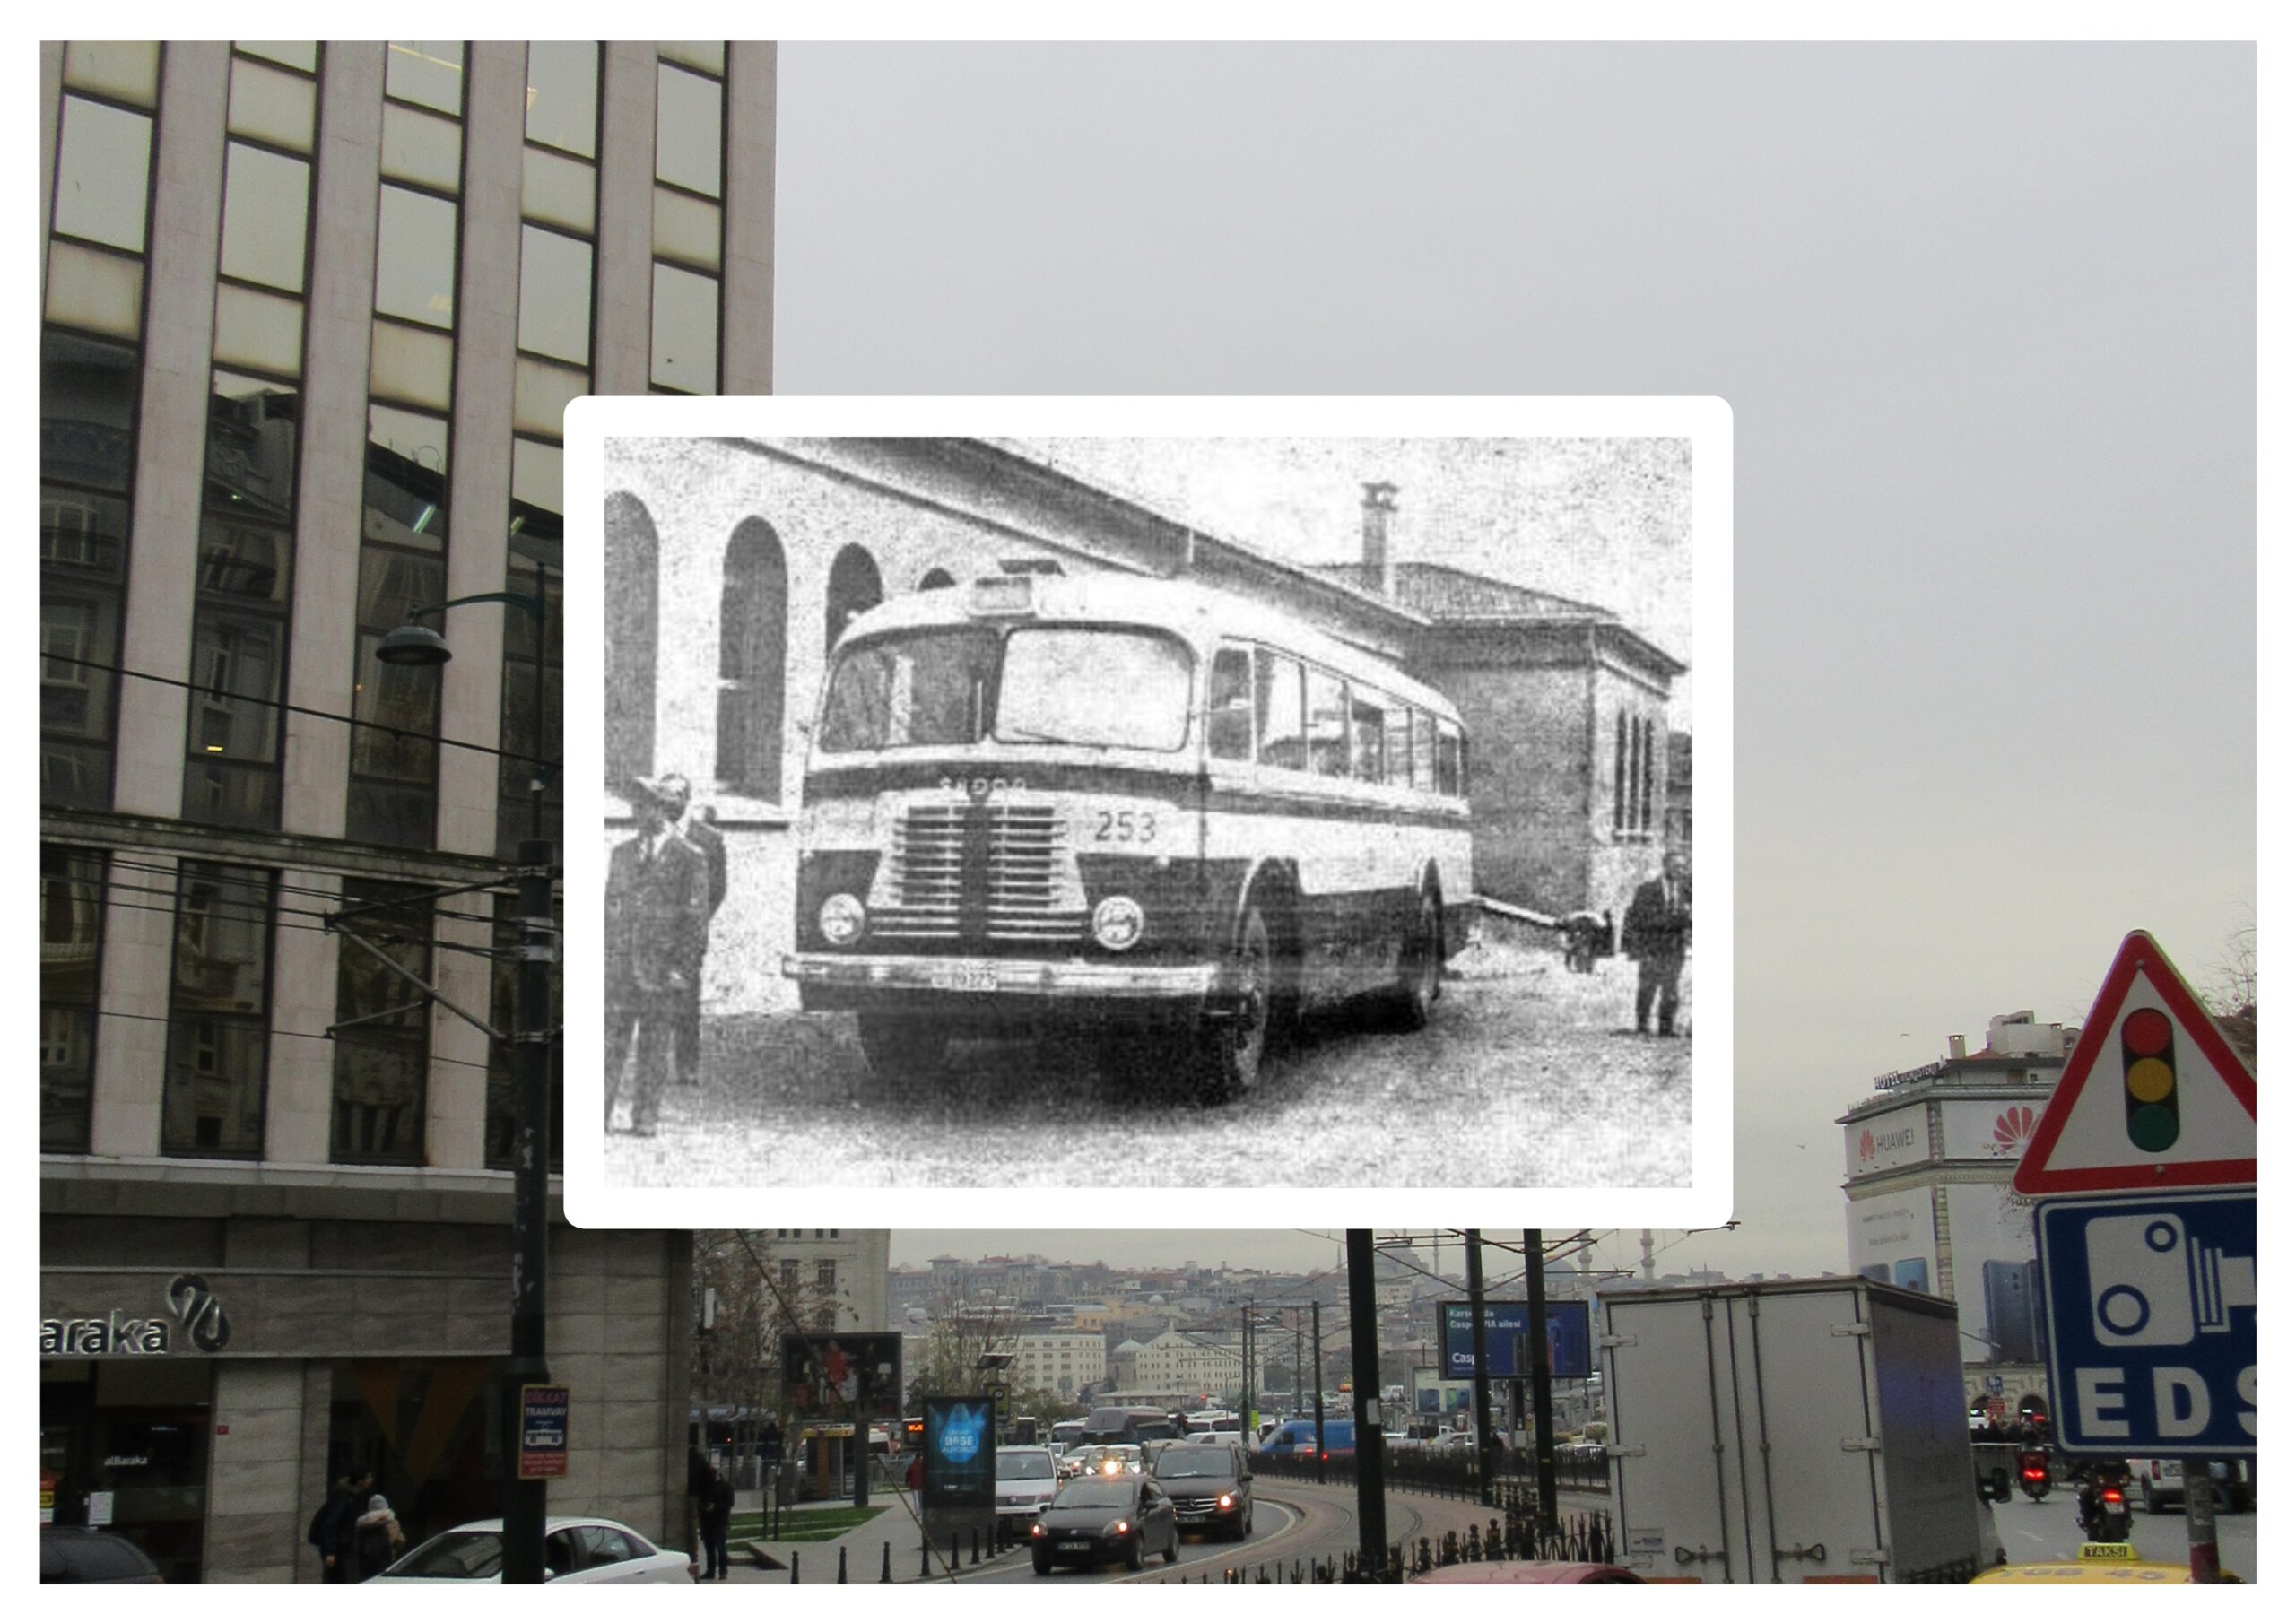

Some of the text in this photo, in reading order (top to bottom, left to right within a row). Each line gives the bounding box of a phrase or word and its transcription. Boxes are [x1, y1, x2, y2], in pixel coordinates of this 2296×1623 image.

[1093, 810, 1157, 843] 253
[1876, 1127, 1915, 1154] HUAWEI
[1498, 1320, 1521, 1328] ailesi
[526, 1406, 567, 1417] TRAMVAY
[103, 1456, 149, 1466] alBaraka
